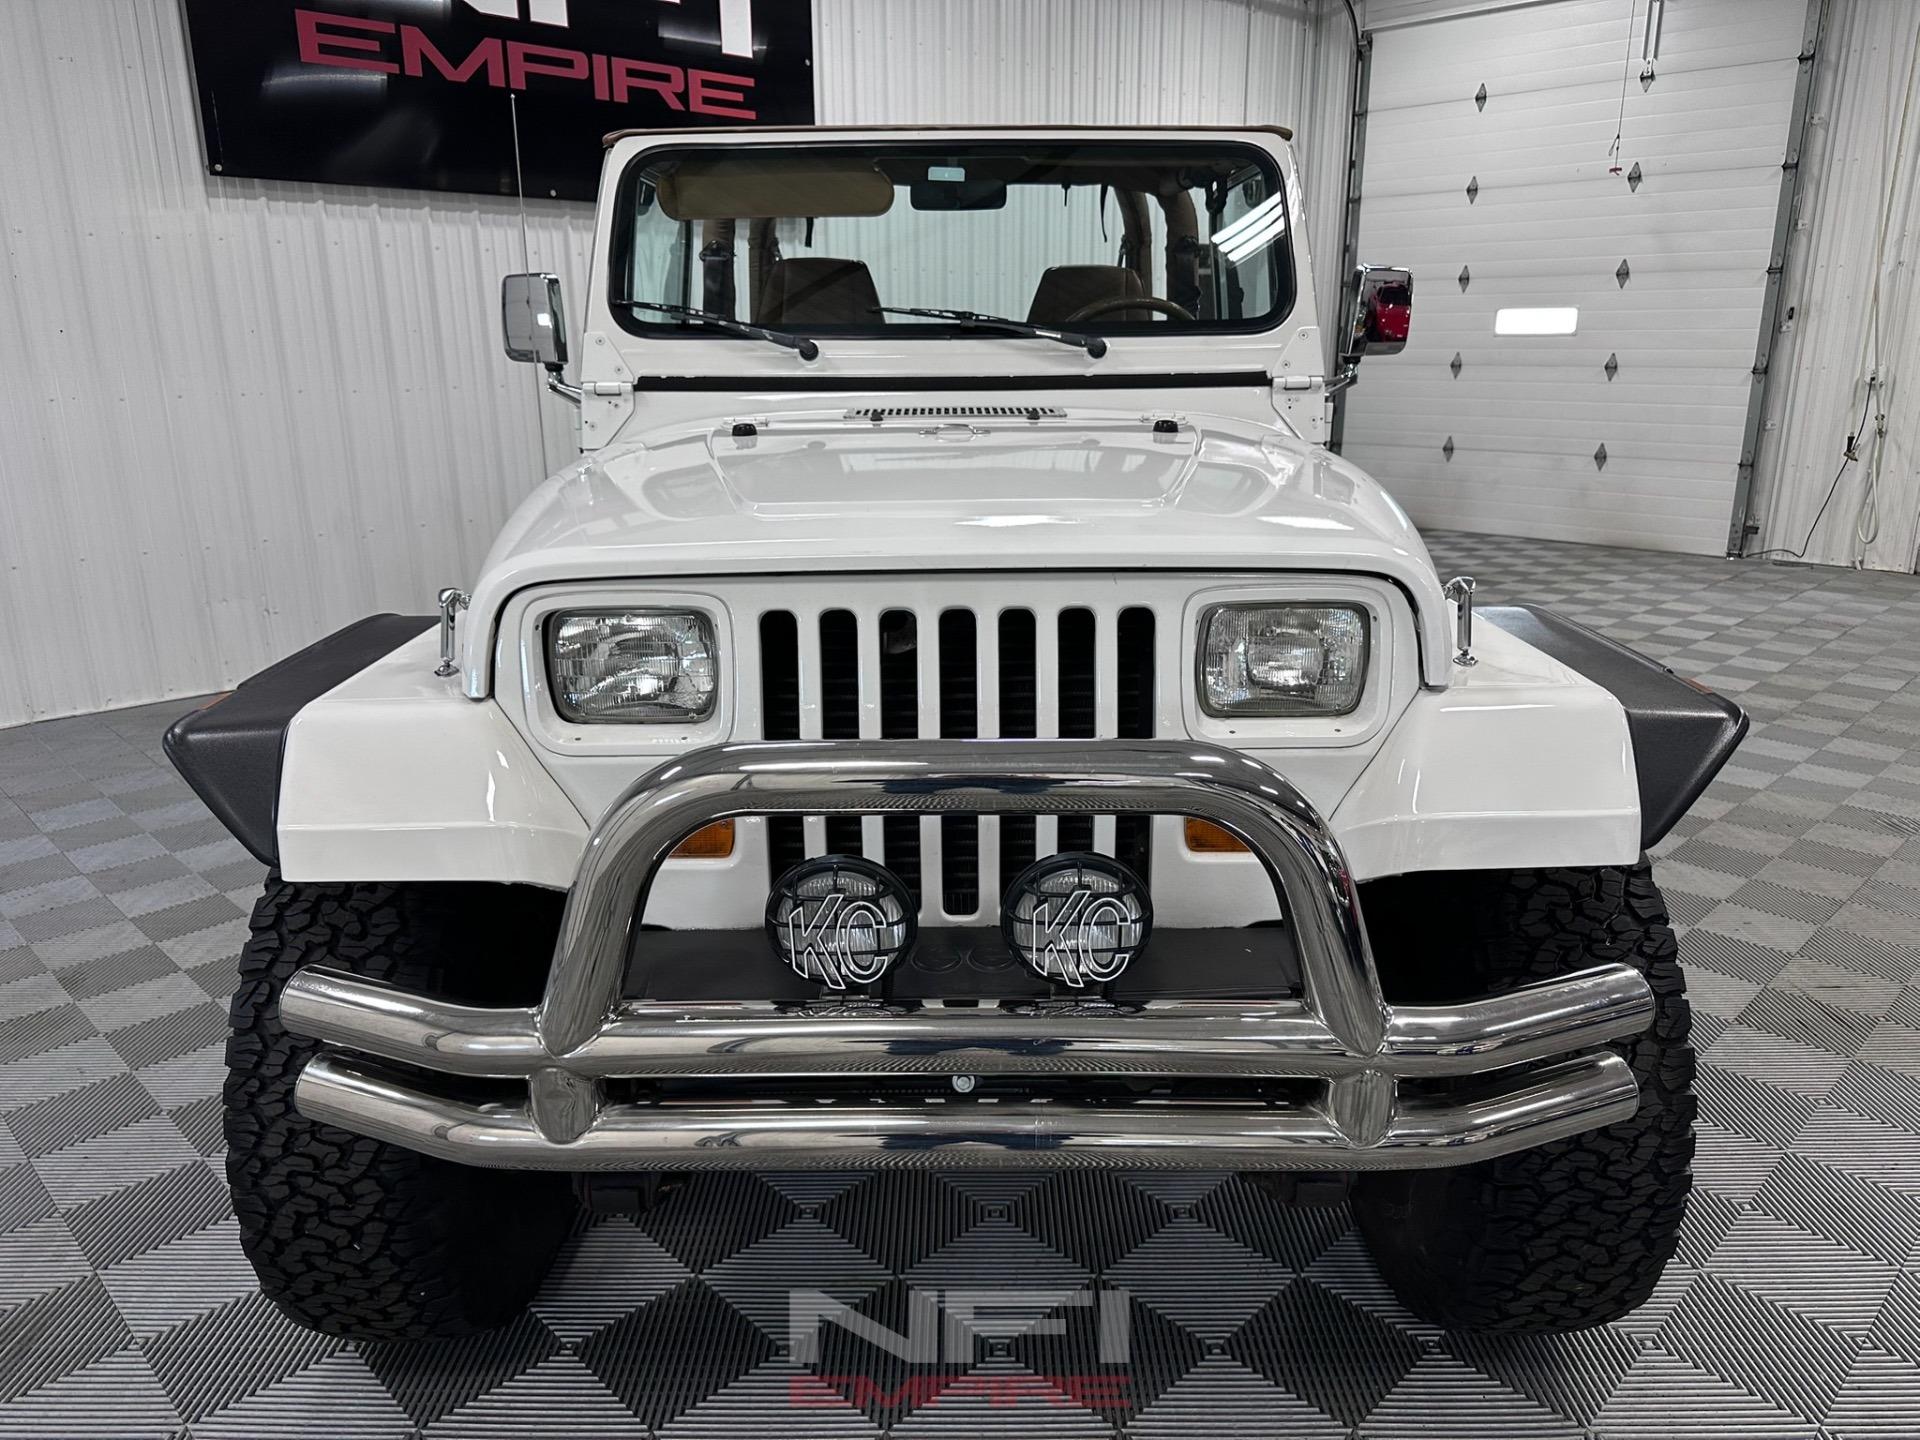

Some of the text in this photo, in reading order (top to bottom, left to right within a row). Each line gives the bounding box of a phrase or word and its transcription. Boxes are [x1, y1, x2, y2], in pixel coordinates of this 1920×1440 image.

[295, 9, 757, 120] EMPIRE
[789, 894, 887, 989] KC
[1032, 891, 1131, 988] KC
